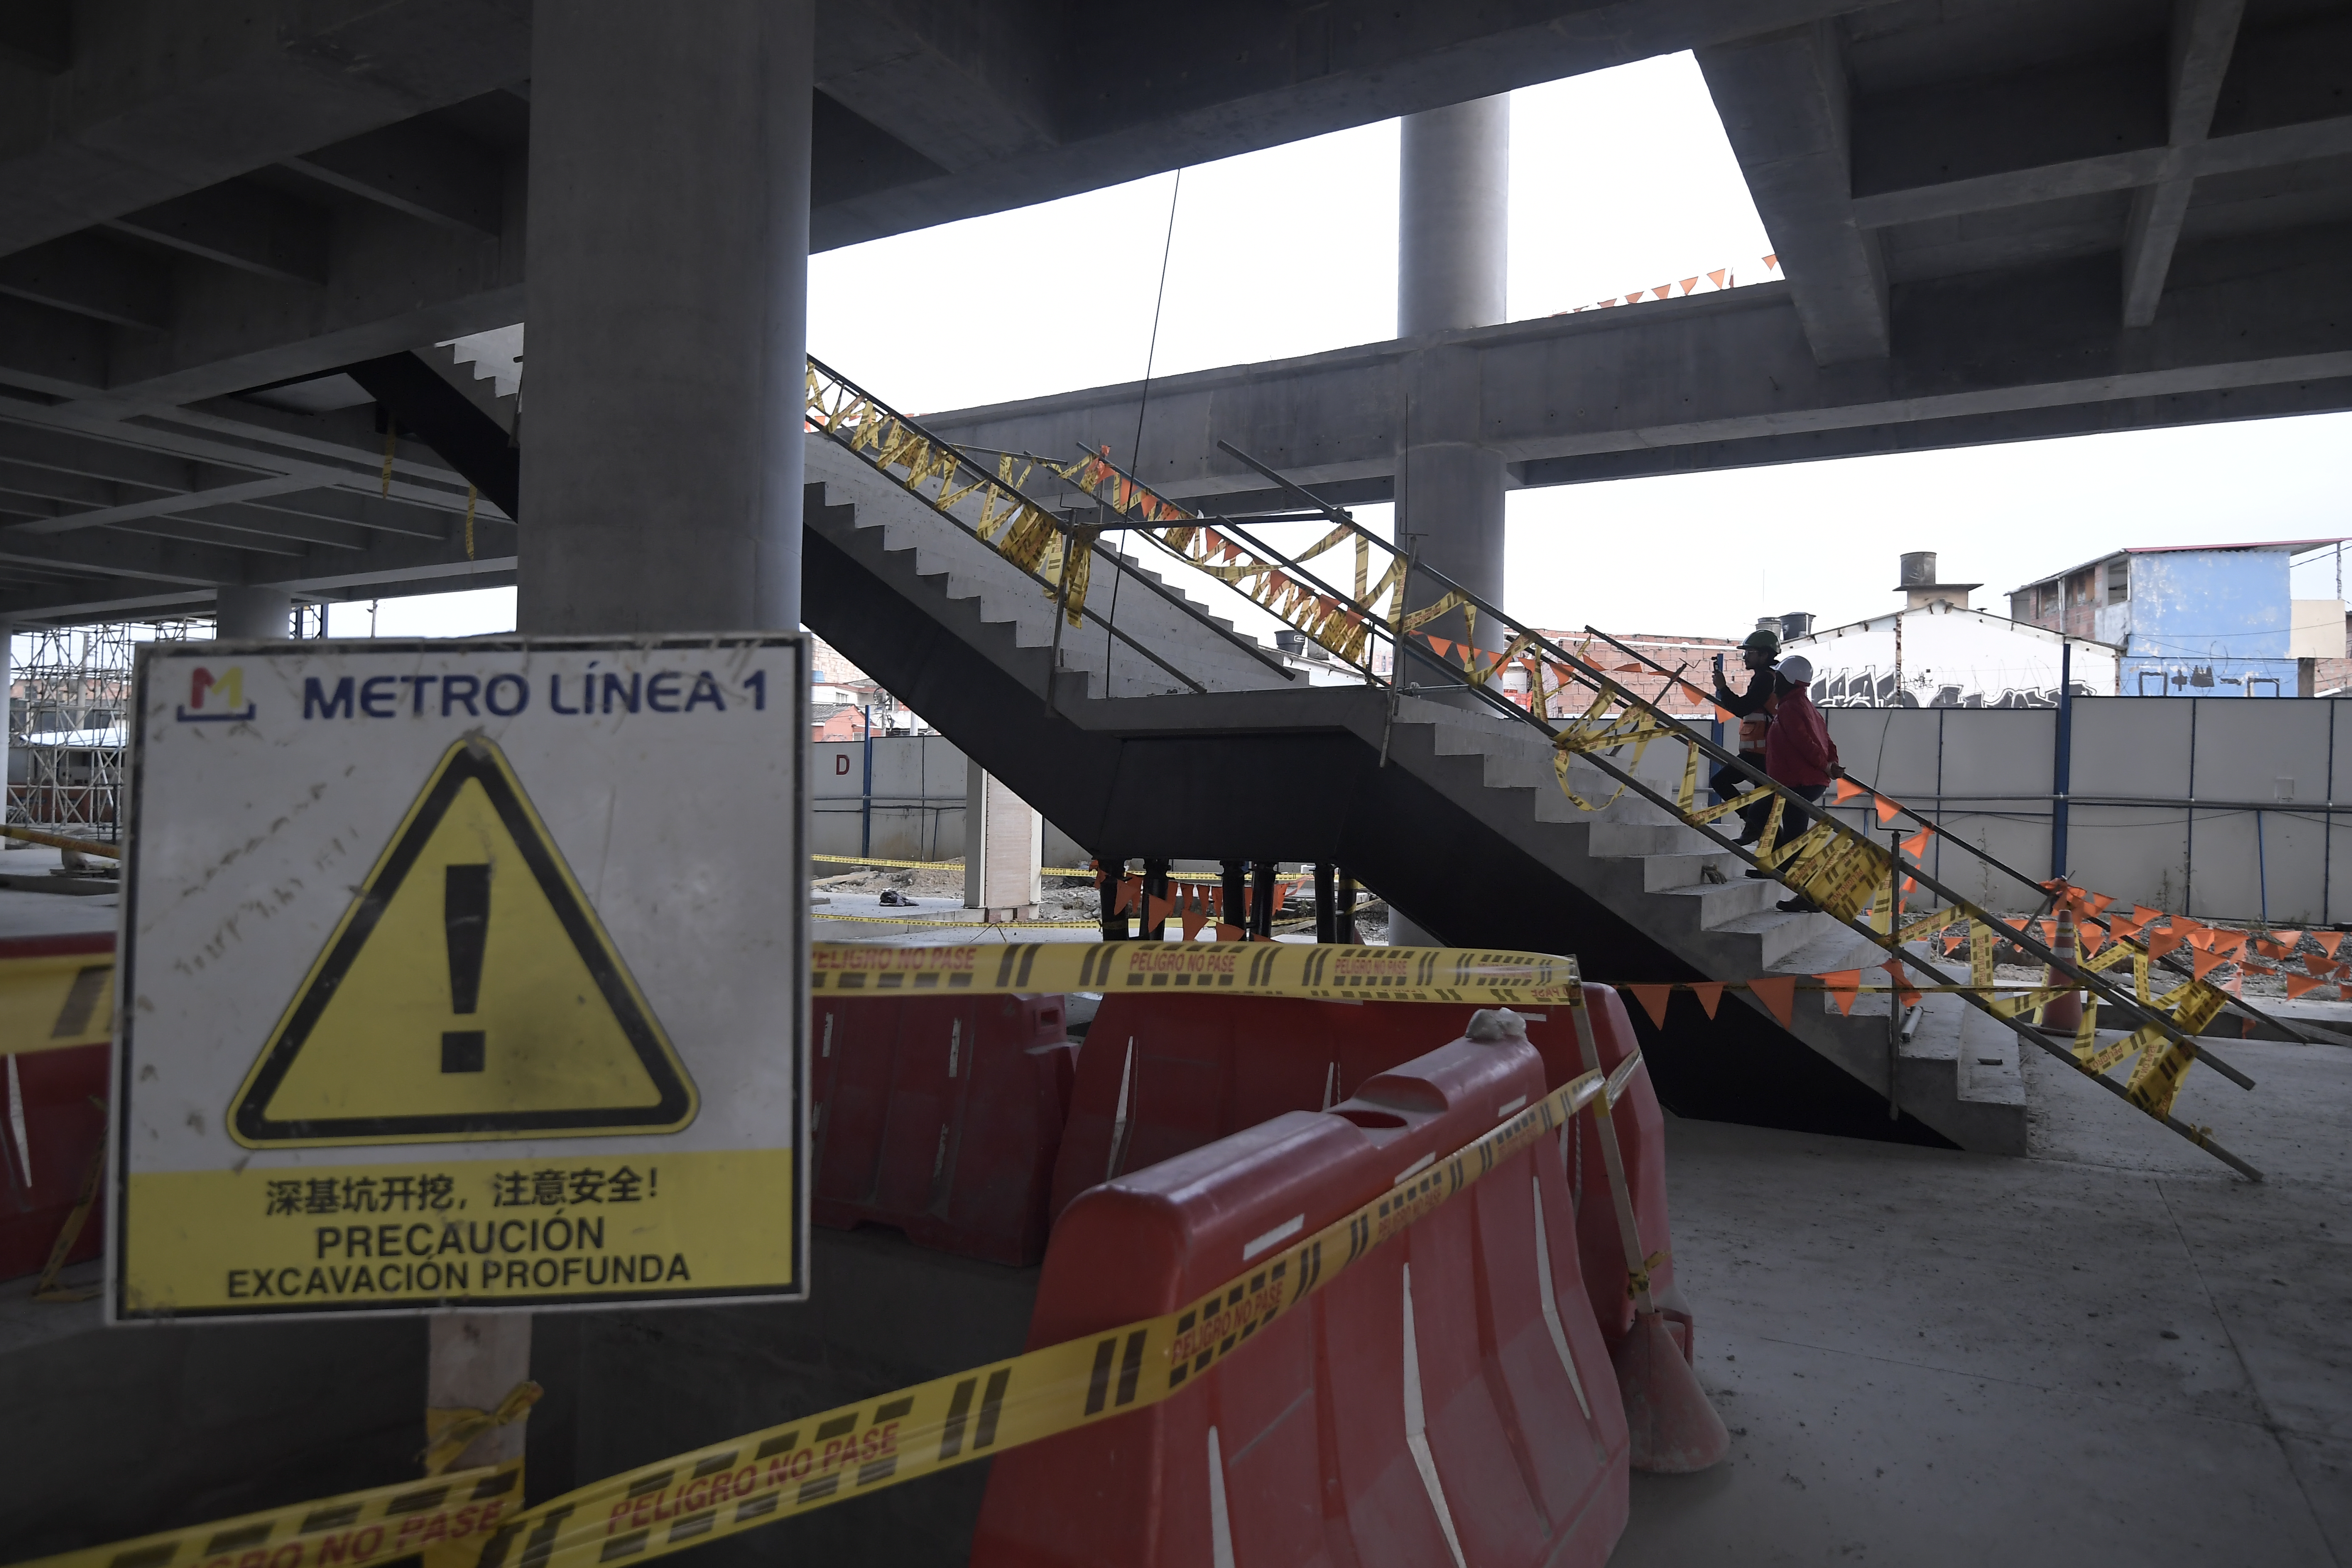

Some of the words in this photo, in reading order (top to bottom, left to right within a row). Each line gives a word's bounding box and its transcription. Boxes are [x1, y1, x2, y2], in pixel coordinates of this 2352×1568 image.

[302, 673, 530, 720] METRO
[550, 662, 726, 715] LÍNEA
[743, 670, 765, 711] 1
[836, 754, 850, 776] D
[1842, 868, 1864, 894] PELIGRO
[1832, 891, 1842, 902] NO
[813, 948, 893, 969] ELIGRO
[898, 947, 926, 969] NO
[930, 947, 977, 969] PASE
[1130, 951, 1185, 972] PELIGRO
[1187, 953, 1205, 972] NO
[1207, 954, 1236, 972] PASE
[1335, 958, 1372, 974] PELIGRO
[1374, 959, 1386, 975] NO
[1388, 960, 1407, 975] PASE
[2092, 1045, 2123, 1069] PELIGRO
[316, 1207, 605, 1259] PRECAUCIÓN
[227, 1255, 469, 1298] EXCAVACIÓN
[482, 1253, 691, 1290] PROFUNDA
[1171, 1309, 1231, 1365] PELIGRO
[1233, 1297, 1253, 1330] NO
[1254, 1280, 1283, 1315] PASE
[607, 1465, 757, 1535] PELIGRO
[767, 1448, 813, 1489] NO
[822, 1421, 901, 1473] PASE
[317, 1524, 385, 1568] NO
[395, 1500, 506, 1552] PASE
